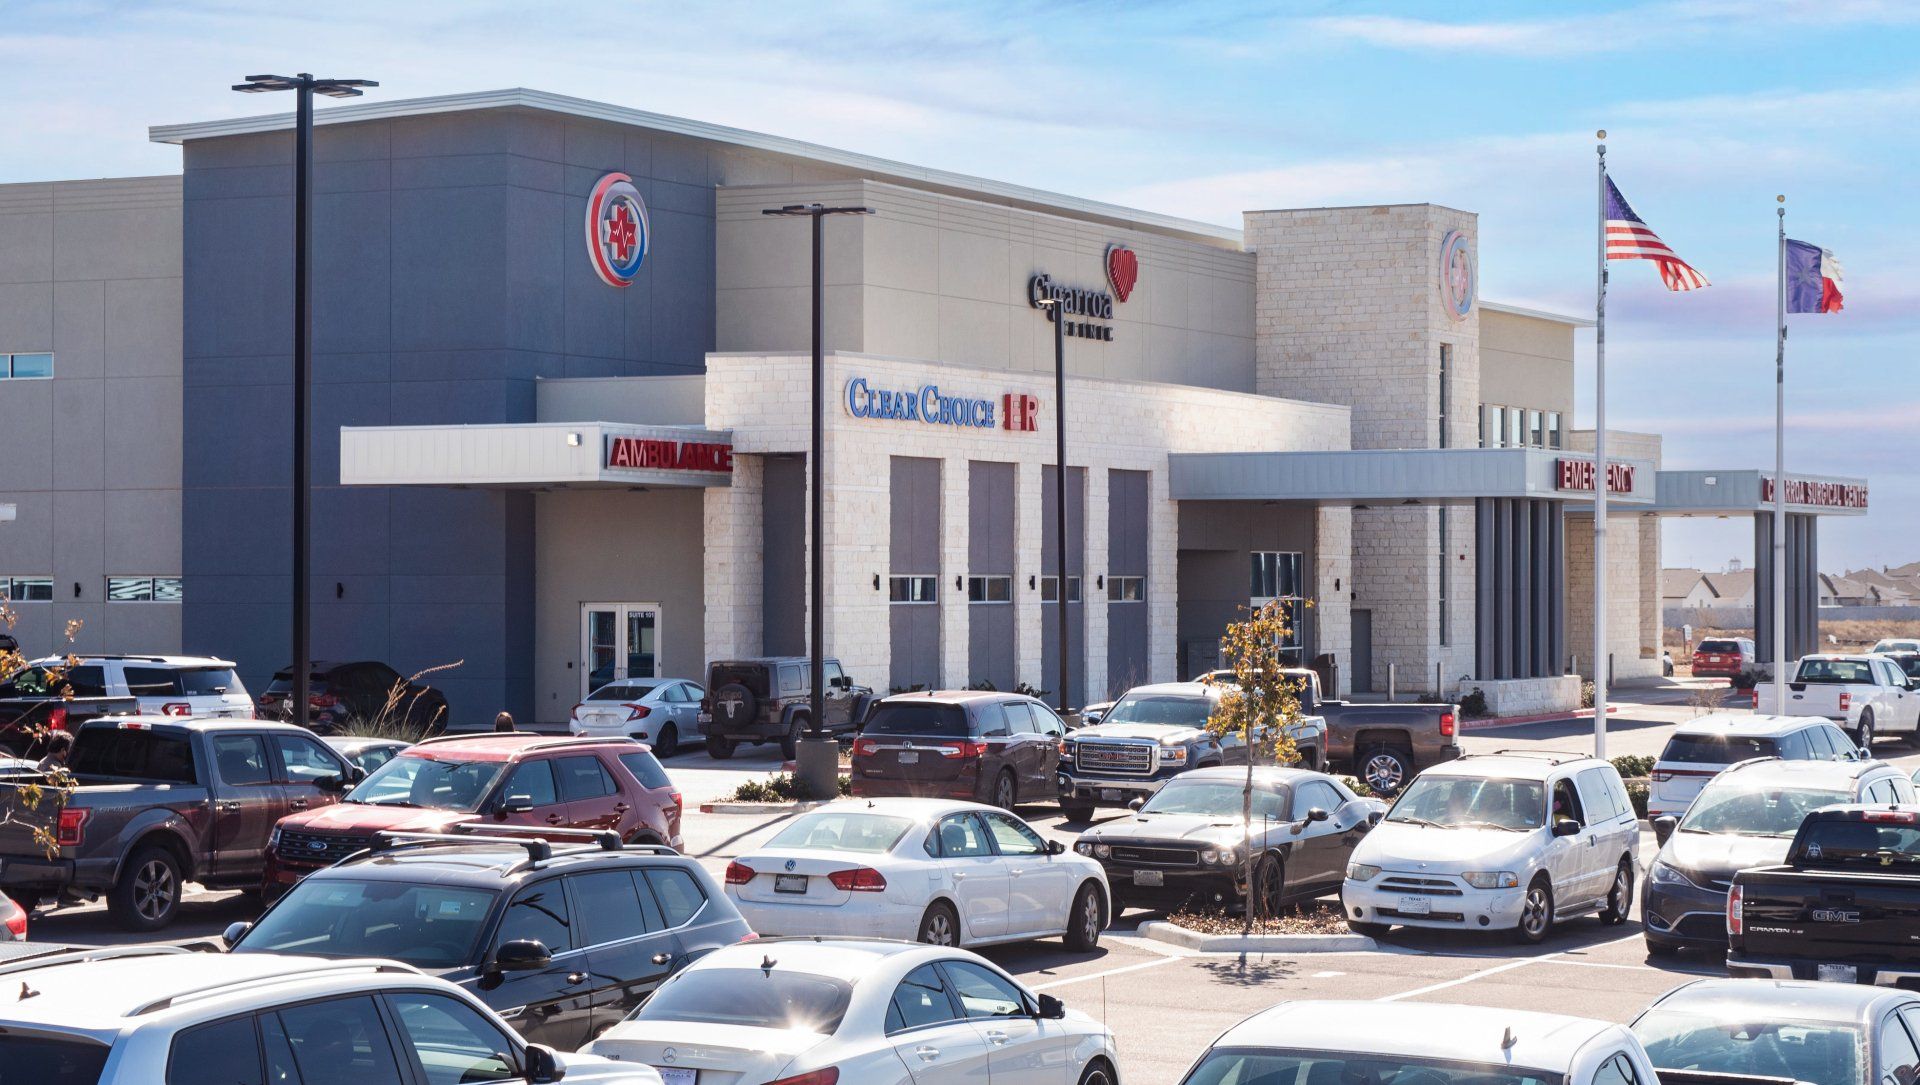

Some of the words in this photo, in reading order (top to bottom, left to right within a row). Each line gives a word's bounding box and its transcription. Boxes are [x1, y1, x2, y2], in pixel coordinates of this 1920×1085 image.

[1002, 393, 1039, 432] ER
[1563, 460, 1637, 493] EMERENCY
[1813, 910, 1860, 923] GMC
[1749, 926, 1790, 934] CANYON
